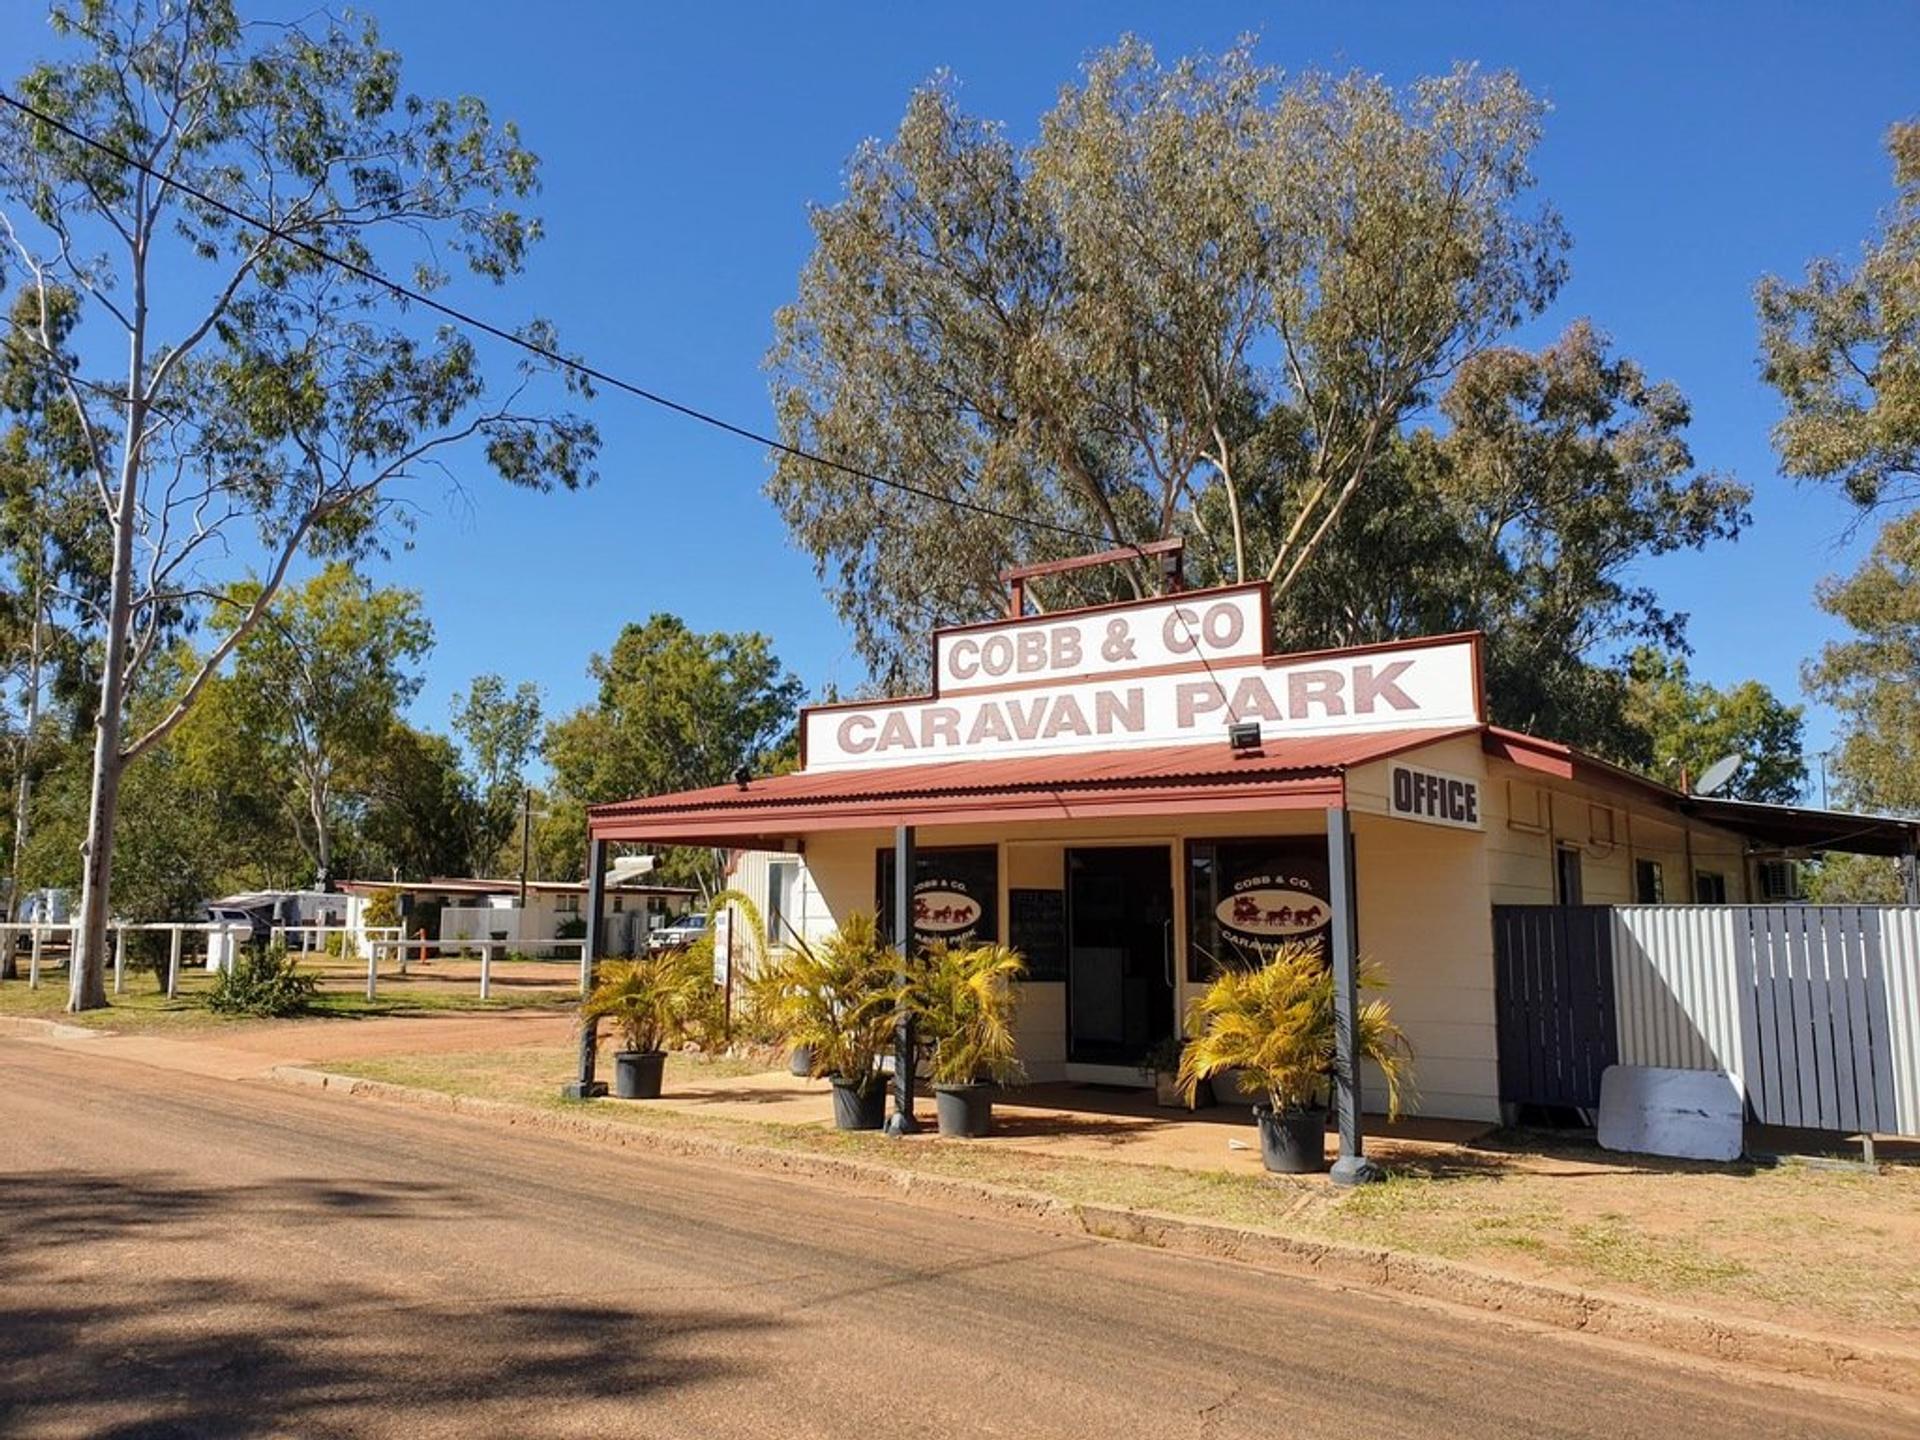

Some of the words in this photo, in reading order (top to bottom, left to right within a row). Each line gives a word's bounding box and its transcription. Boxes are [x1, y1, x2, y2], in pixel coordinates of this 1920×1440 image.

[948, 625, 1084, 681] COBB
[1100, 617, 1138, 664] &
[1162, 601, 1245, 655] CO
[836, 686, 1146, 755] CARAVAN
[1175, 659, 1421, 729] PARK
[1393, 767, 1478, 823] OFFICE
[1233, 875, 1271, 891] COBB
